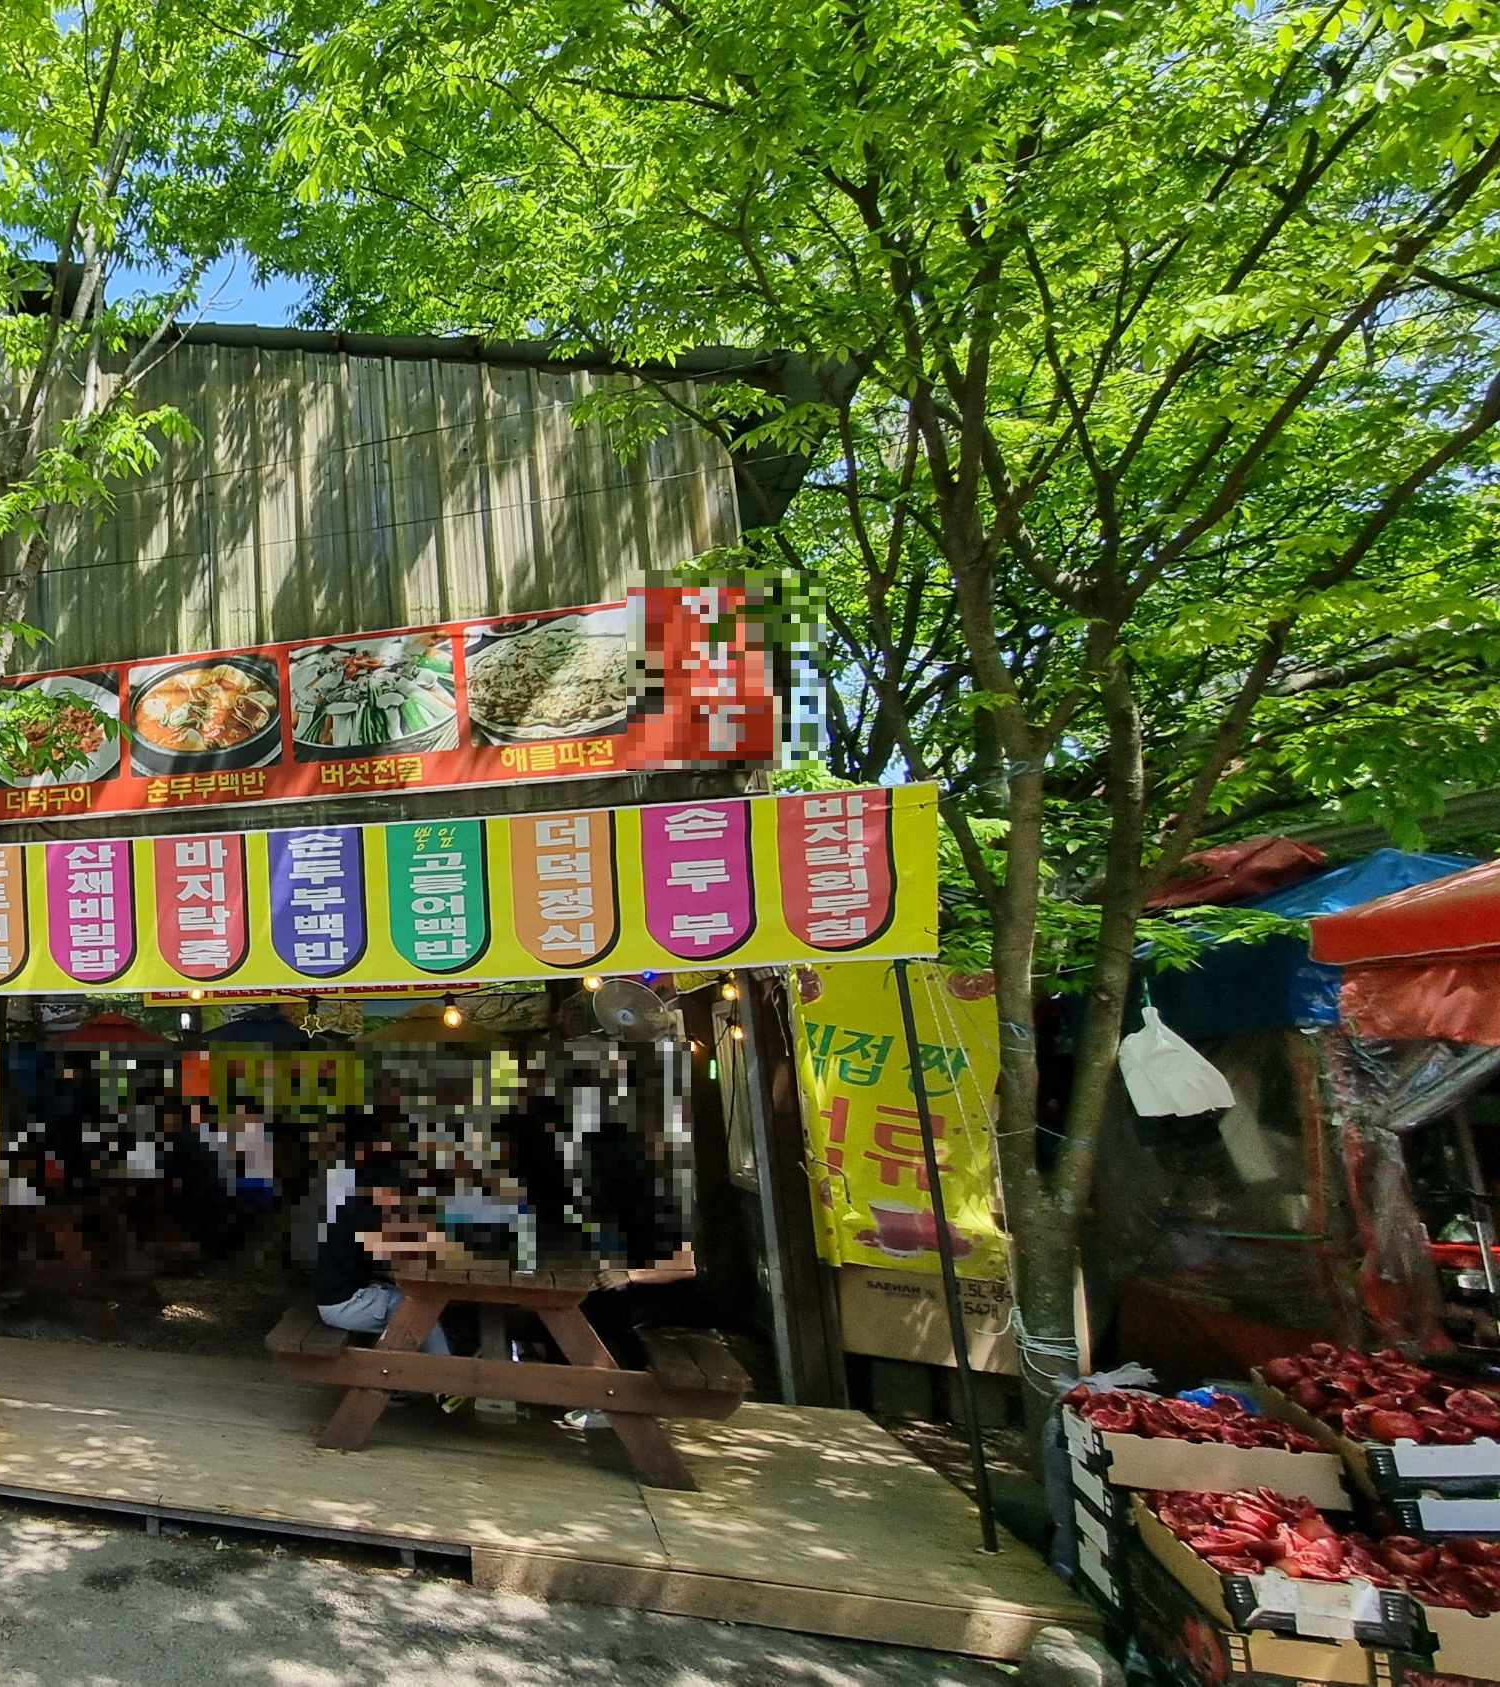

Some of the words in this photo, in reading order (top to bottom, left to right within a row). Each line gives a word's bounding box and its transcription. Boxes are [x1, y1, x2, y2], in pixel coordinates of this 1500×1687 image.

[6, 785, 92, 812] 더덕구이
[147, 771, 266, 804] 순두부백반
[320, 756, 423, 788] 버섯전골
[501, 739, 616, 773] 해물파전
[64, 844, 120, 973] 산채비빔밥
[174, 838, 232, 969] 바지락죽
[287, 832, 349, 967] 순두부백반
[409, 852, 472, 960] 고등어백반
[534, 816, 596, 955] 더덕정식
[664, 807, 734, 945] 손두부
[803, 795, 872, 942] 바지락회무침
[866, 1280, 921, 1295] SAEHAN
